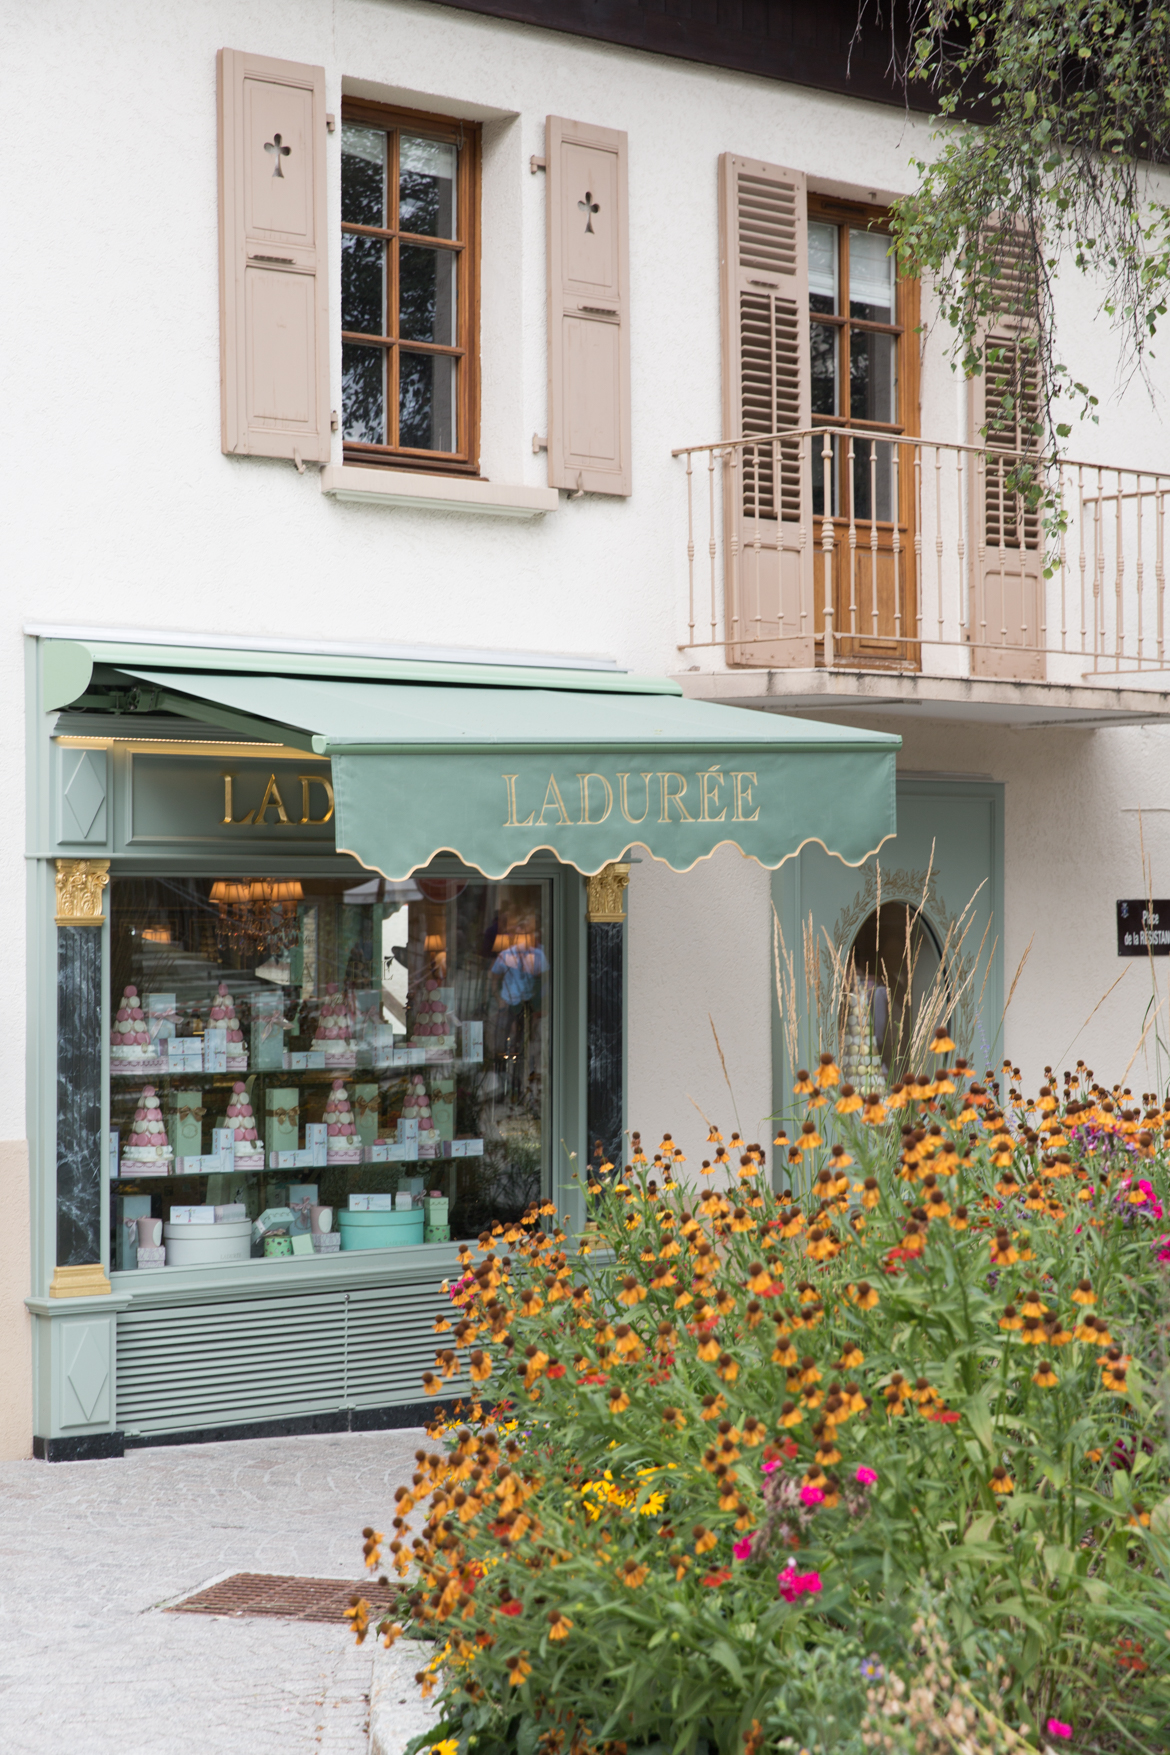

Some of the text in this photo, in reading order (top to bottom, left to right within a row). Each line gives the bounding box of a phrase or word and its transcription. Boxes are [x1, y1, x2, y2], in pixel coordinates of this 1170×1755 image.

[219, 773, 334, 825] LAD
[501, 765, 760, 827] LADURÉE
[1124, 931, 1132, 946] de
[1133, 931, 1139, 946] la
